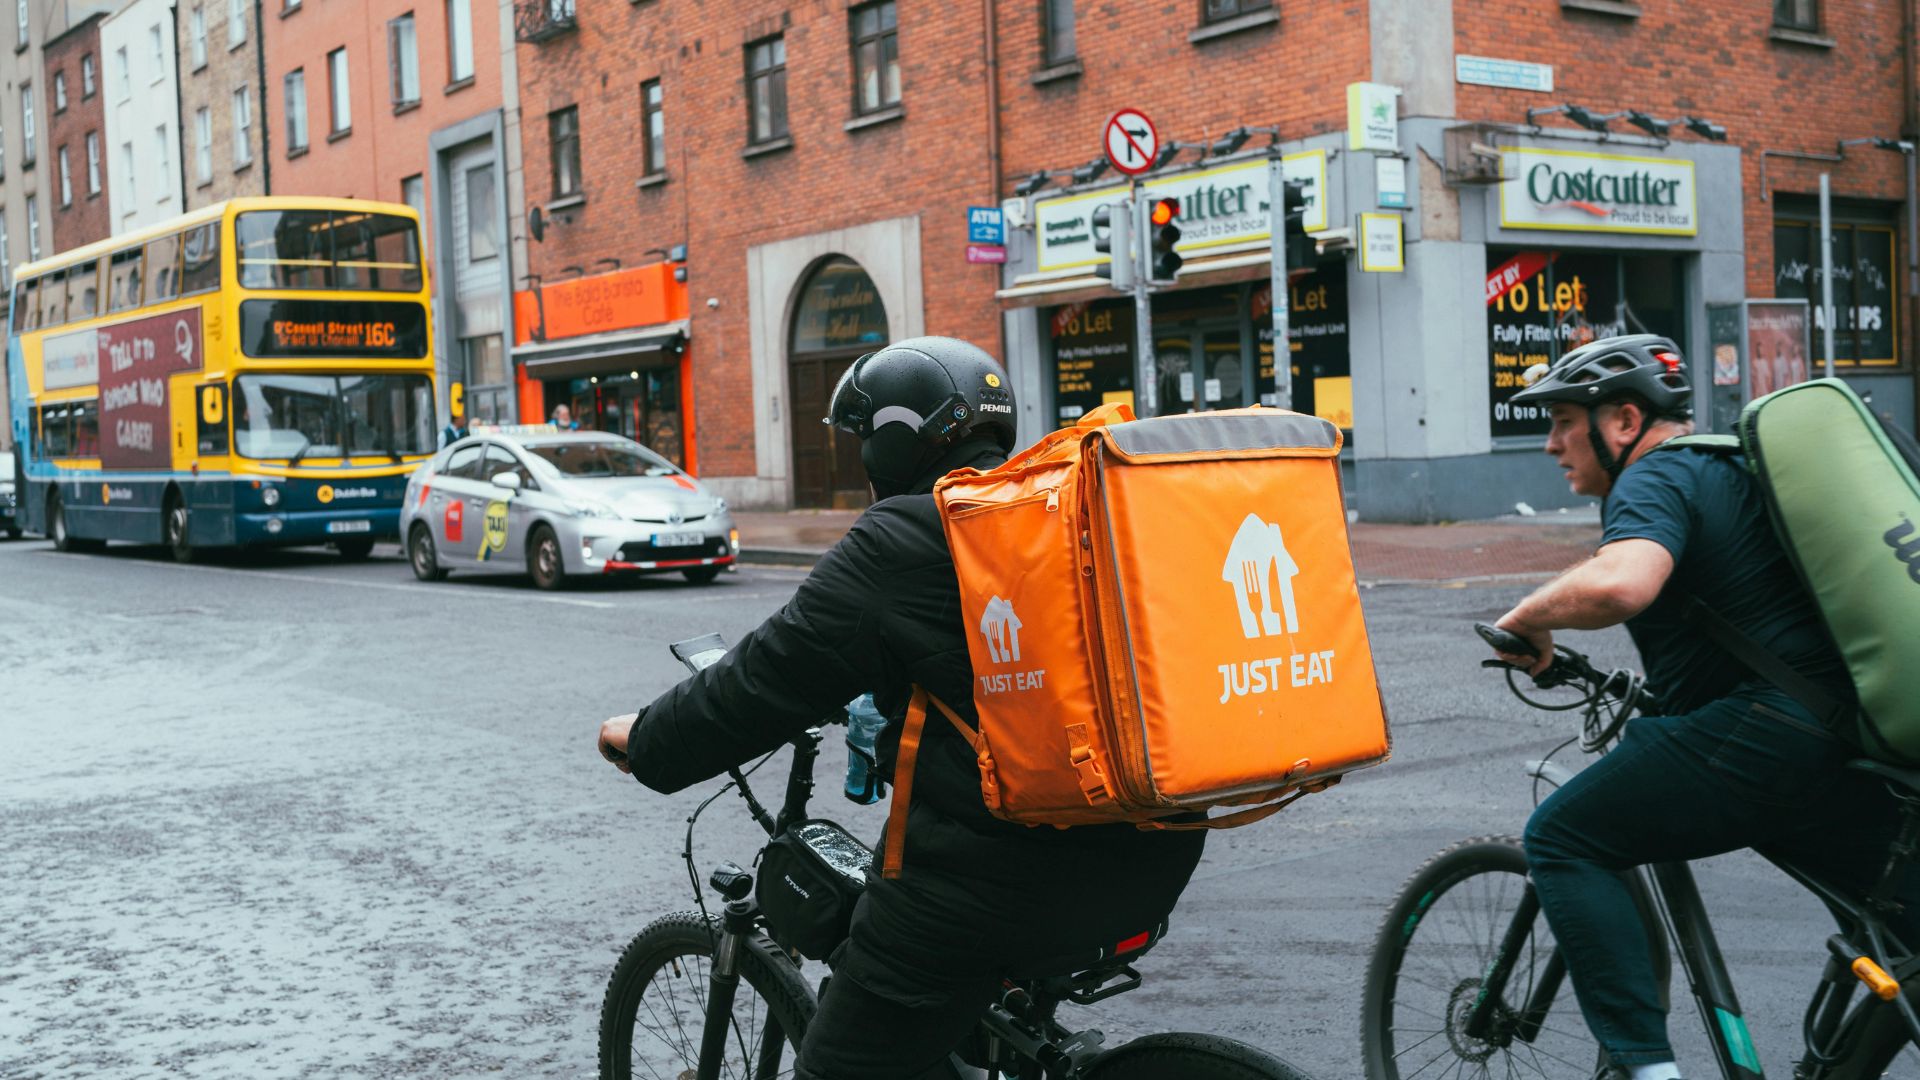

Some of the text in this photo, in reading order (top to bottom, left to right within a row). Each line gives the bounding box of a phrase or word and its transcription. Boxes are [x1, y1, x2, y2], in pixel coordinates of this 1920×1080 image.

[1528, 163, 1681, 206] Costcutter
[971, 209, 1001, 225] ATM
[1210, 225, 1221, 236] to
[1223, 219, 1238, 234] be
[1240, 216, 1267, 232] local
[1611, 209, 1689, 225] Proud to be local
[1503, 262, 1521, 286] BY
[1292, 284, 1328, 312] Let
[1537, 273, 1583, 312] Let
[327, 321, 363, 335] Street
[364, 321, 396, 347] 16C
[1083, 309, 1113, 335] Let
[1327, 322, 1346, 335] Unit
[1493, 324, 1523, 346] Fully
[110, 339, 134, 373] TELL
[1494, 353, 1549, 367] New Lease
[1495, 373, 1514, 387] 220
[139, 377, 165, 408] WHO
[1495, 403, 1510, 421] 01
[487, 515, 505, 533] TAXI
[980, 669, 1046, 696] JUST EAT
[1217, 649, 1335, 705] JUST EAT
